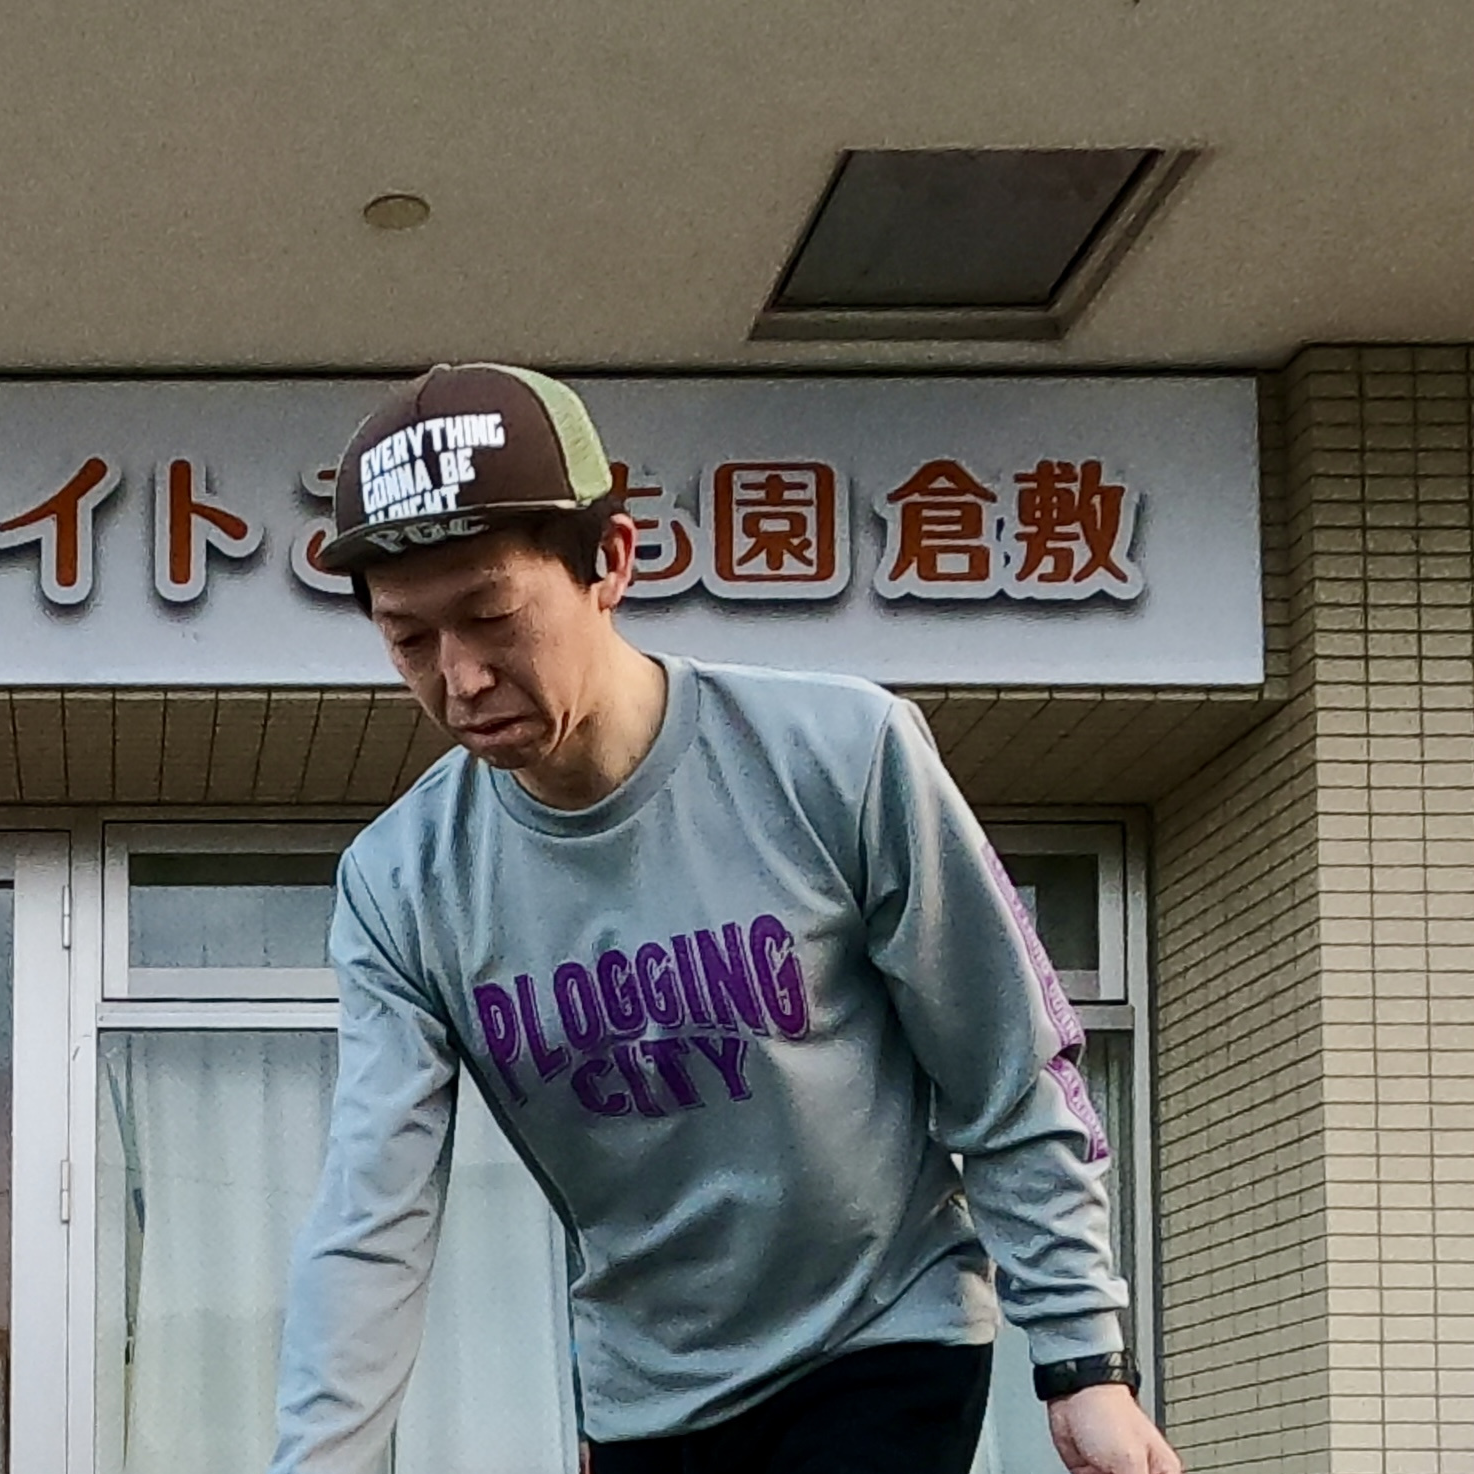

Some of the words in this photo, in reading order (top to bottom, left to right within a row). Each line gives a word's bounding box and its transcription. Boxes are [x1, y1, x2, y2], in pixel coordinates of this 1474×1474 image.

[360, 412, 505, 485] EVERYTHING
[362, 458, 433, 515] GONNA
[438, 447, 476, 486] BE
[472, 913, 810, 1107] PLOGGING
[569, 1036, 752, 1118] CITY
